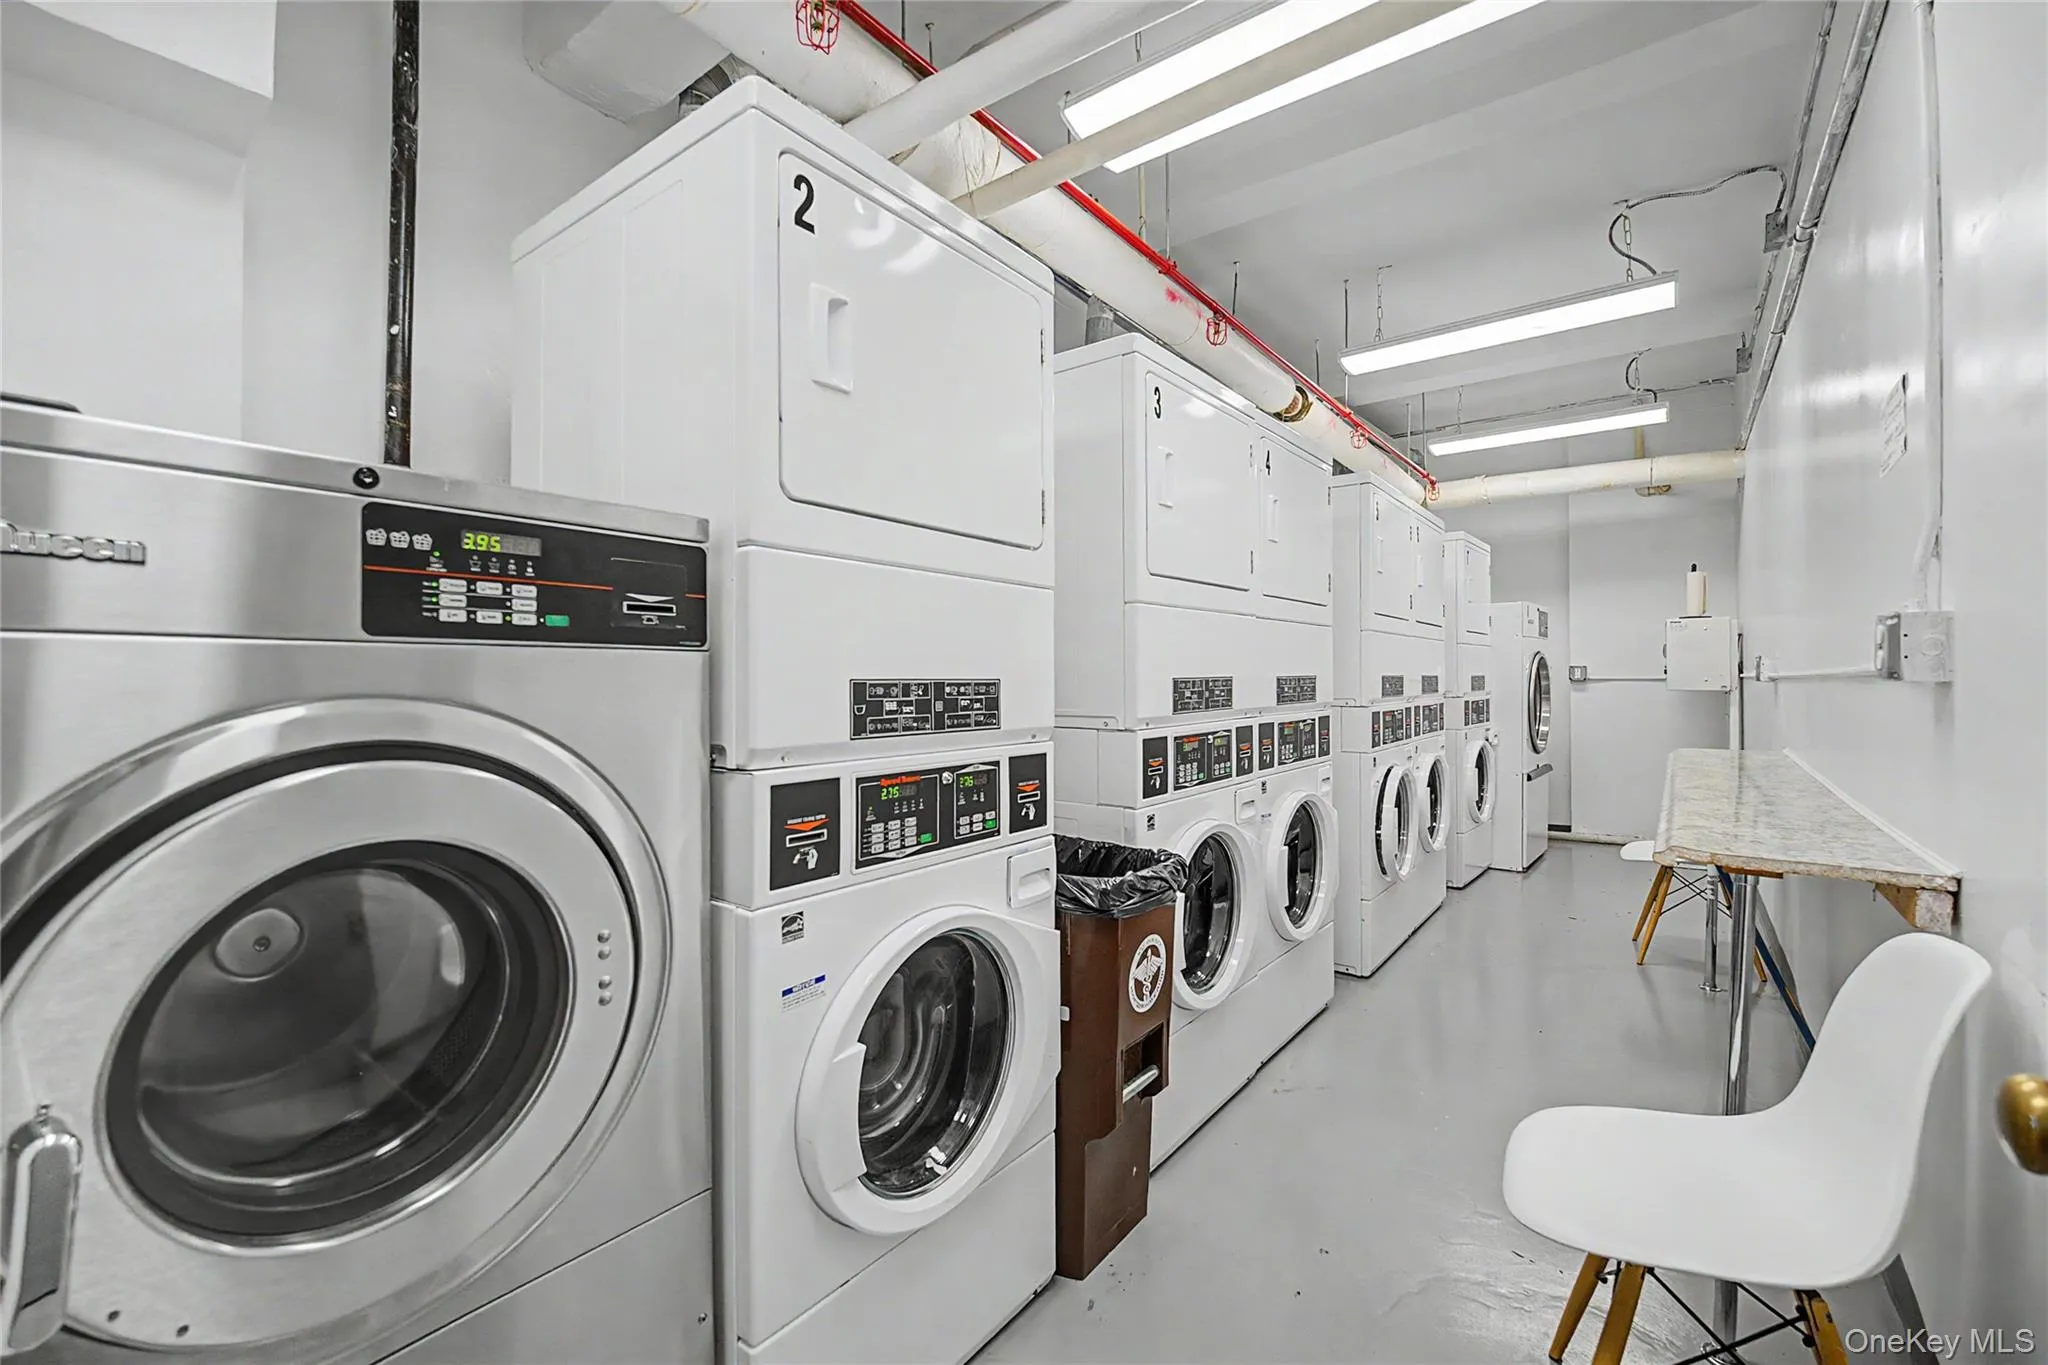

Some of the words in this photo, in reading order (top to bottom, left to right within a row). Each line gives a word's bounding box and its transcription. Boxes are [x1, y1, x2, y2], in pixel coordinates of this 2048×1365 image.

[794, 173, 815, 235] 2
[1154, 386, 1161, 419] 3
[1266, 450, 1271, 476] 4
